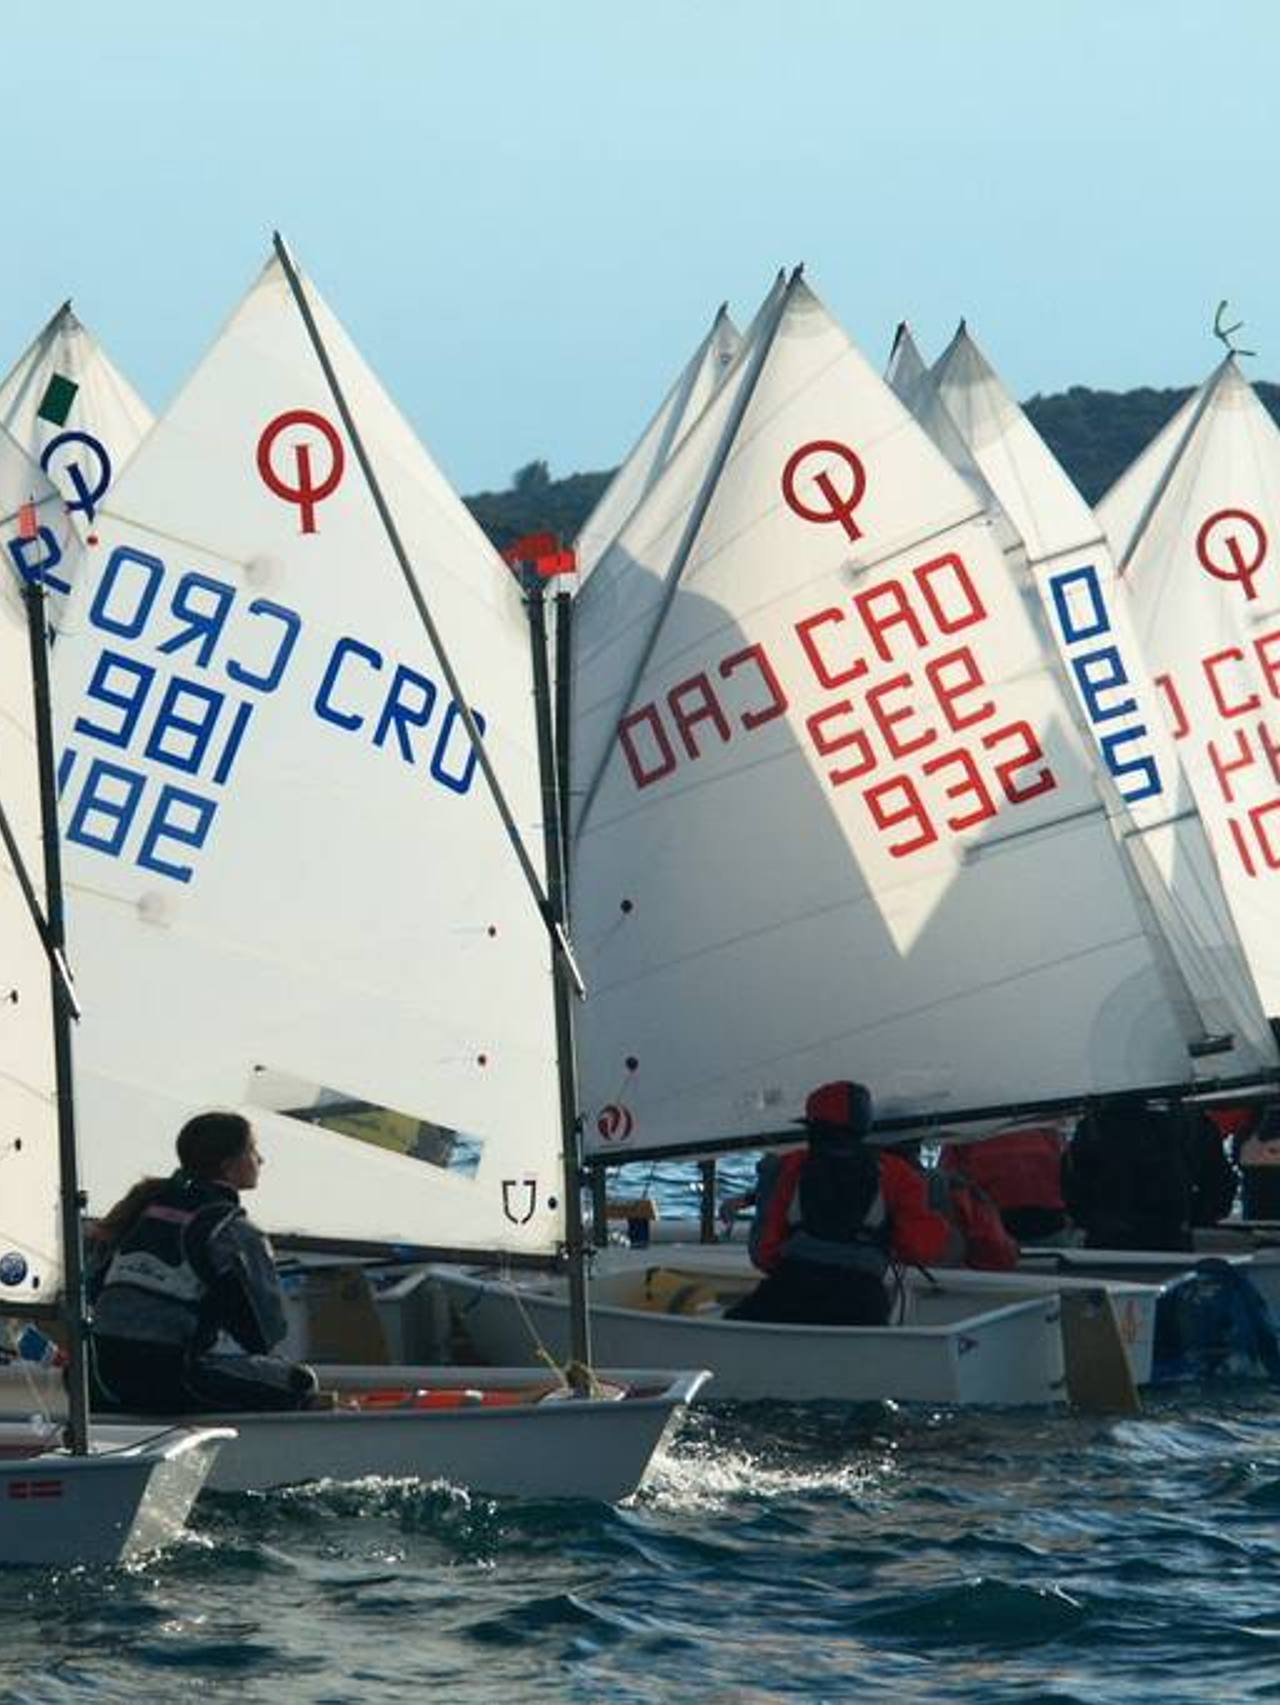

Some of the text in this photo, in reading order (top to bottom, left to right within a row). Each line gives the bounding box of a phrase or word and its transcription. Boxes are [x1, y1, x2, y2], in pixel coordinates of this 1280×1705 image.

[73, 649, 255, 785] 981
[314, 636, 487, 795] CRO
[863, 719, 1058, 858] 932
